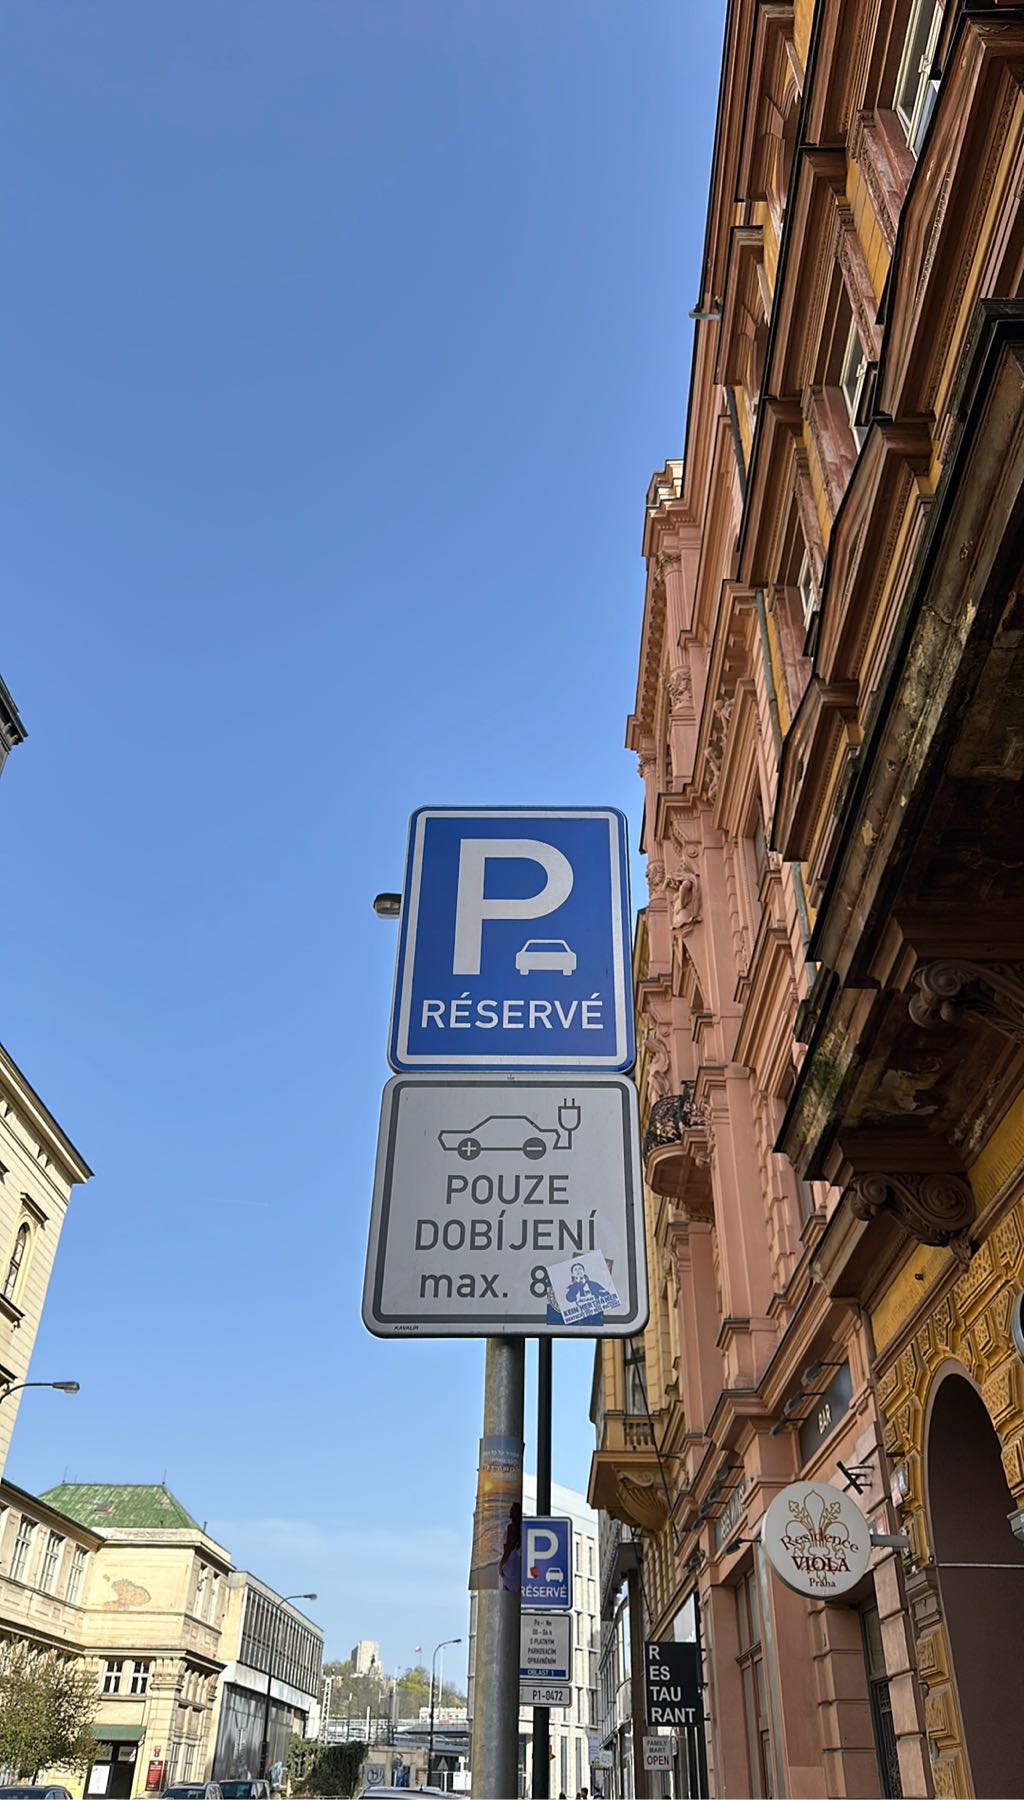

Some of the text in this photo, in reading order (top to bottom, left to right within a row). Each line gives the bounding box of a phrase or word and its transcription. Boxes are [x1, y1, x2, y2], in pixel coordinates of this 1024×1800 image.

[453, 838, 574, 975] P
[421, 991, 604, 1029] RÉSERVÉ
[446, 1174, 569, 1205] POUZE
[415, 1209, 597, 1251] DOBÍJENÍ
[419, 1265, 547, 1298] max. 8
[818, 1403, 832, 1434] BAR
[780, 1528, 859, 1553] Residence
[527, 1528, 558, 1579] P
[792, 1555, 851, 1572] VIOLA
[809, 1577, 836, 1587] Praha
[649, 1645, 660, 1660] R
[649, 1665, 670, 1681] ES
[532, 1690, 563, 1701] P1-0472
[650, 1686, 681, 1702] TAU
[651, 1707, 696, 1723] RANT
[647, 1755, 669, 1765] OPEN
